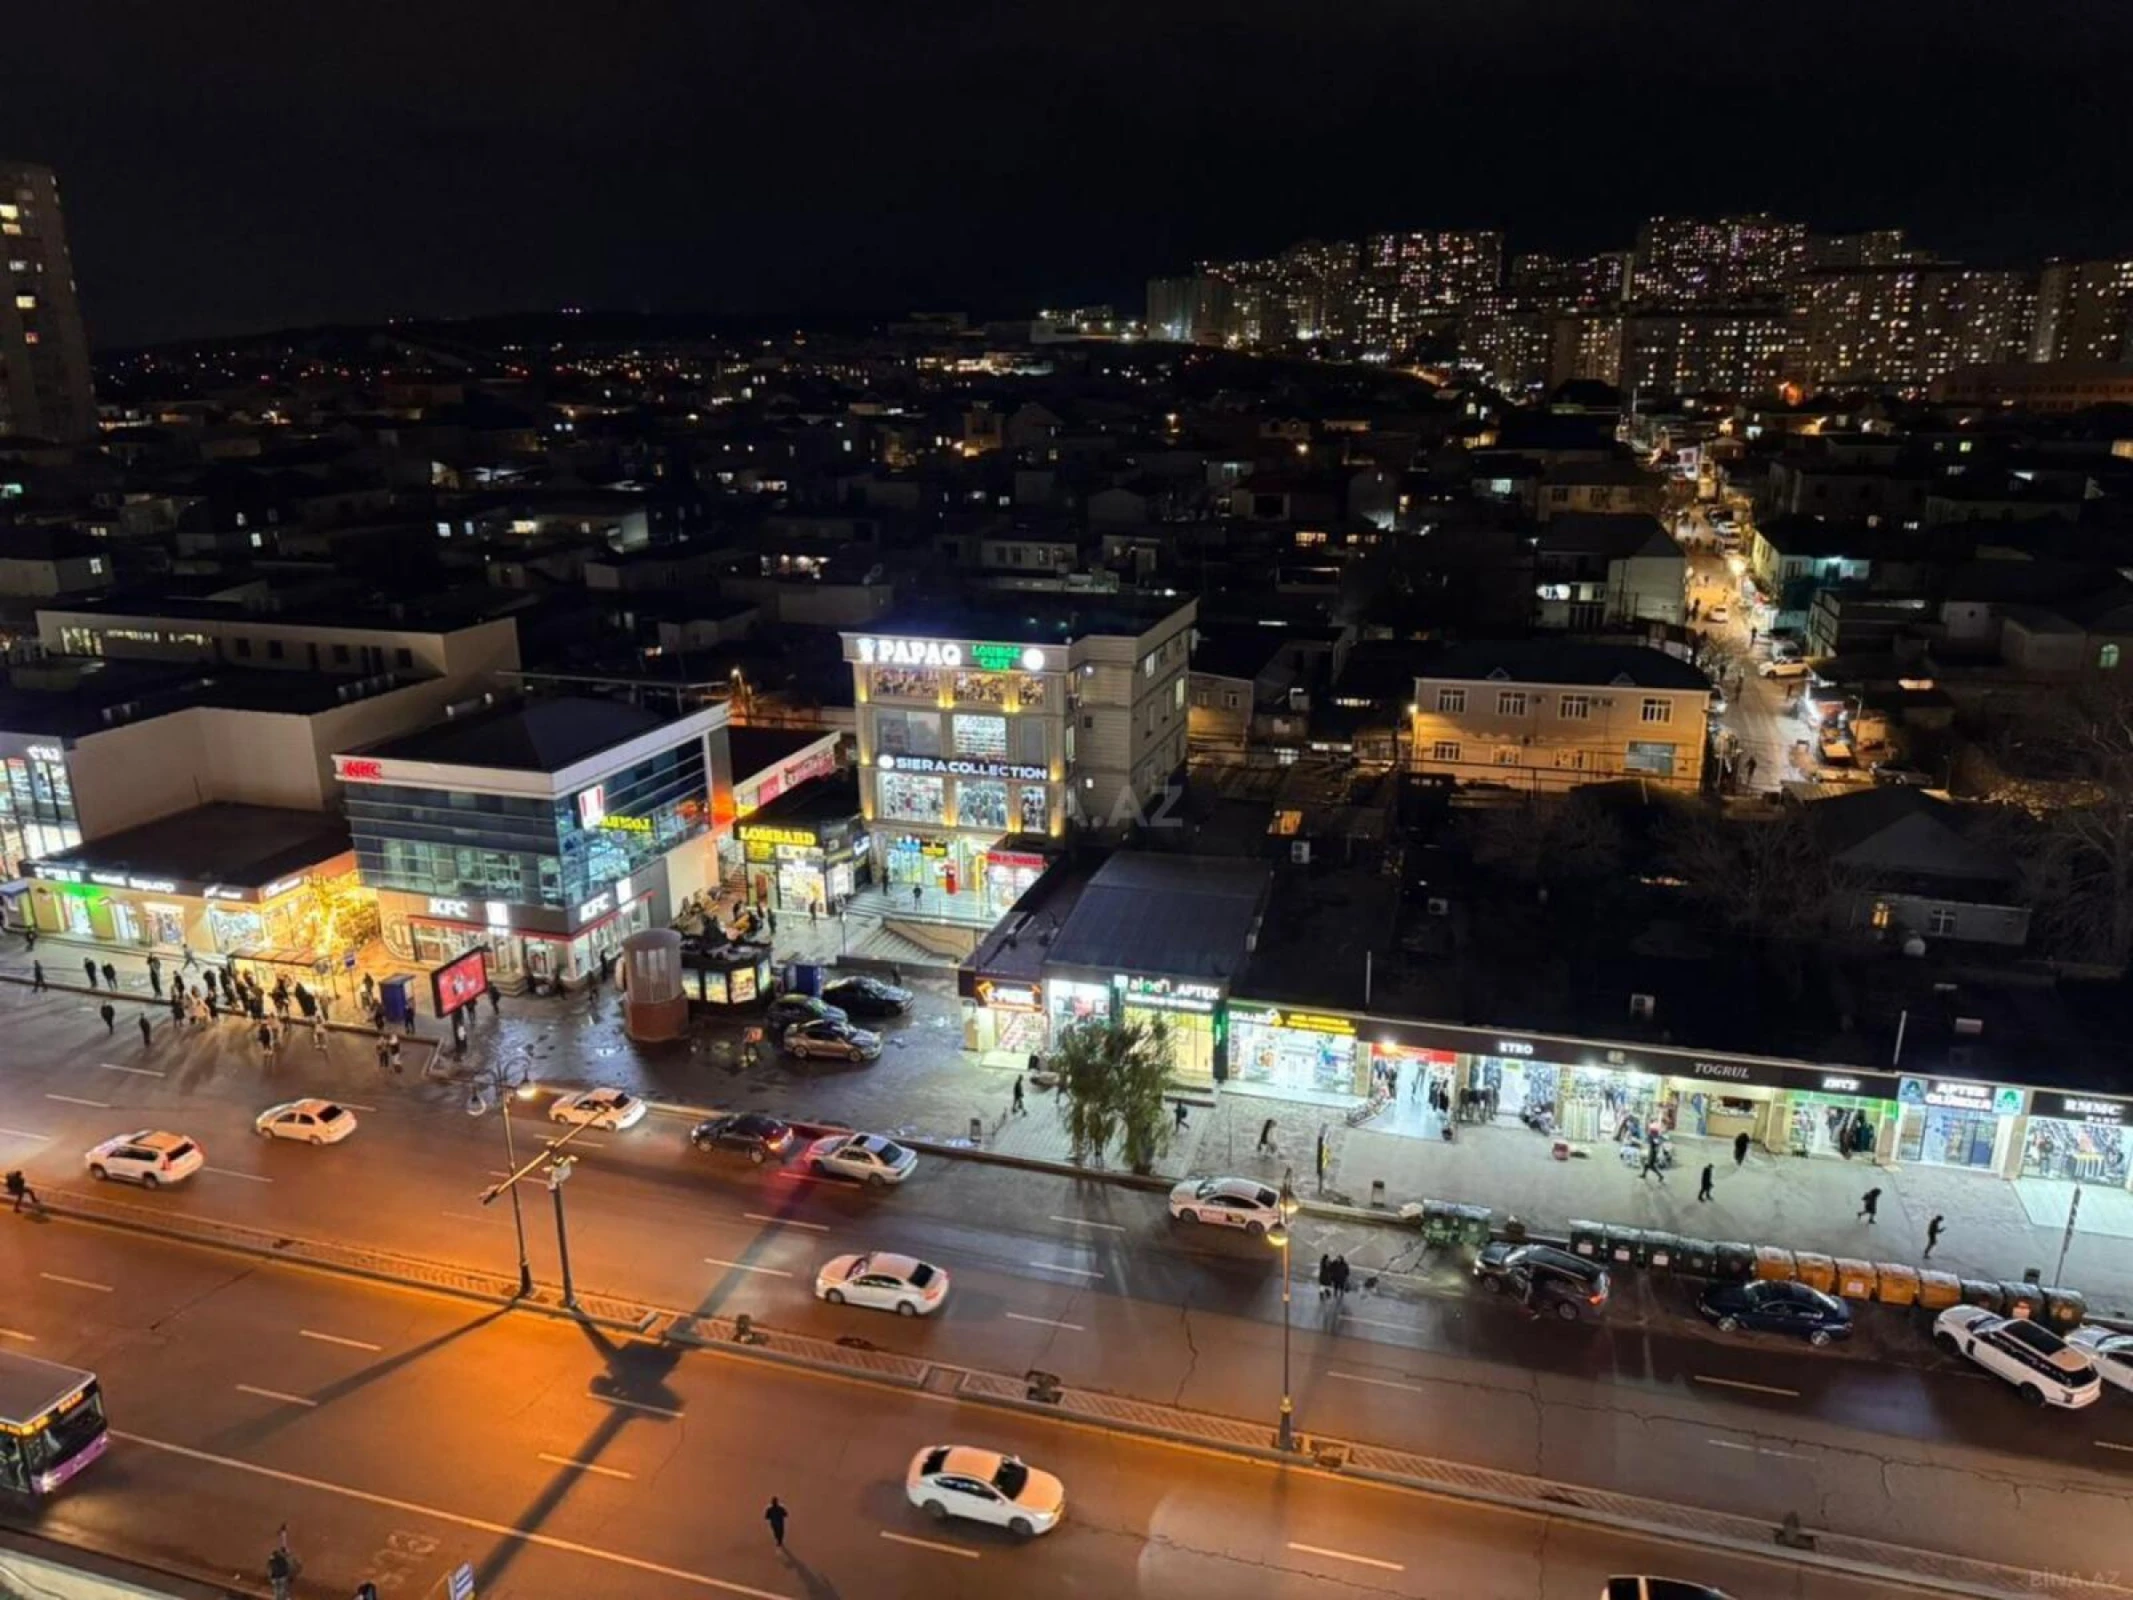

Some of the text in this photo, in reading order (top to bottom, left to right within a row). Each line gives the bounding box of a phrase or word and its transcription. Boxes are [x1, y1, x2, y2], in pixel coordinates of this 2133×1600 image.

[878, 640, 961, 666] PAPAQ
[972, 645, 1020, 659] LOUNGE
[981, 658, 1012, 670] CAFE
[896, 757, 1048, 780] SIERA COLLECTION
[739, 826, 816, 846] LOMBARD
[429, 897, 468, 918] KFC
[580, 893, 611, 922] KFC
[1693, 1062, 1750, 1079] TOGRUL
